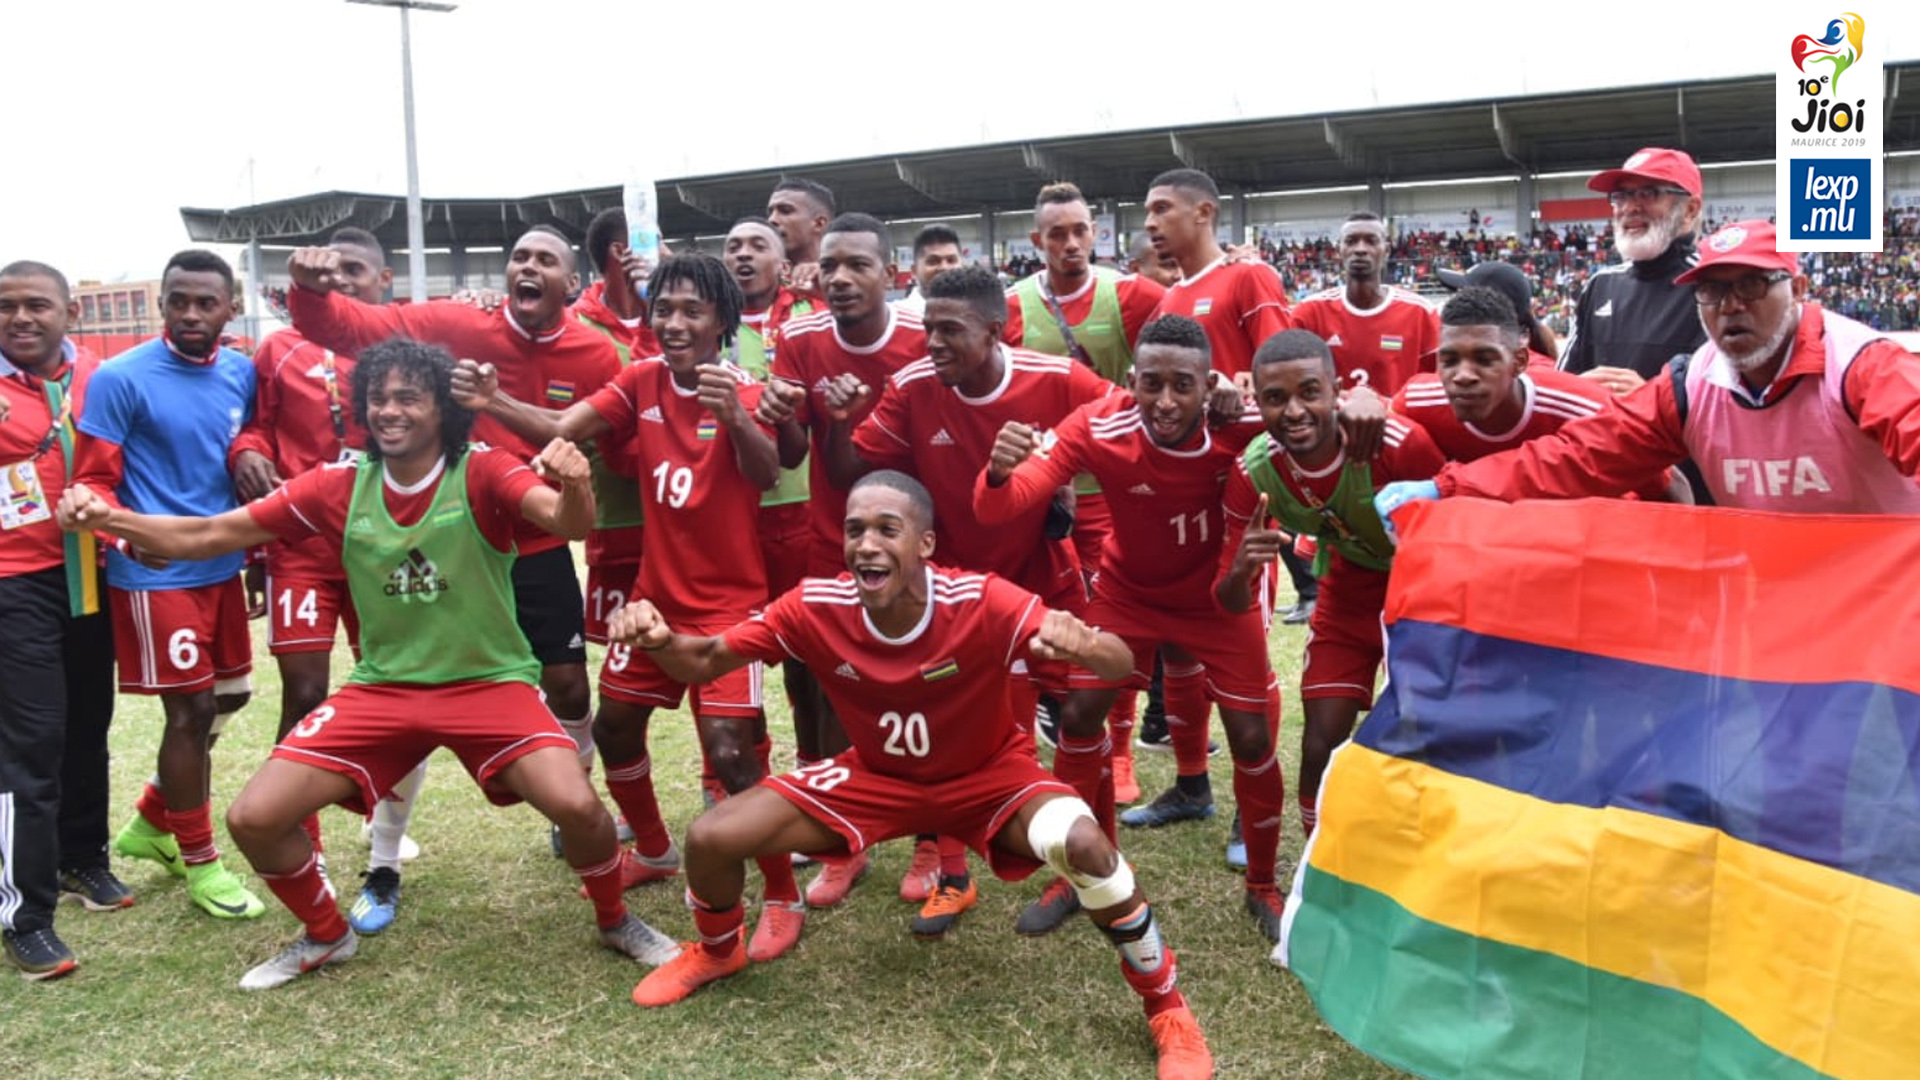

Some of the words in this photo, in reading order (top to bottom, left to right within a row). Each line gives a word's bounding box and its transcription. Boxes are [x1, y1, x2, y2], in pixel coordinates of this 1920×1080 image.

[652, 460, 694, 509] 19
[1723, 455, 1832, 496] FIFA
[1169, 509, 1208, 545] 11
[278, 588, 319, 627] 14
[591, 586, 625, 624] 12
[168, 628, 199, 670] 6
[878, 711, 930, 757] 20
